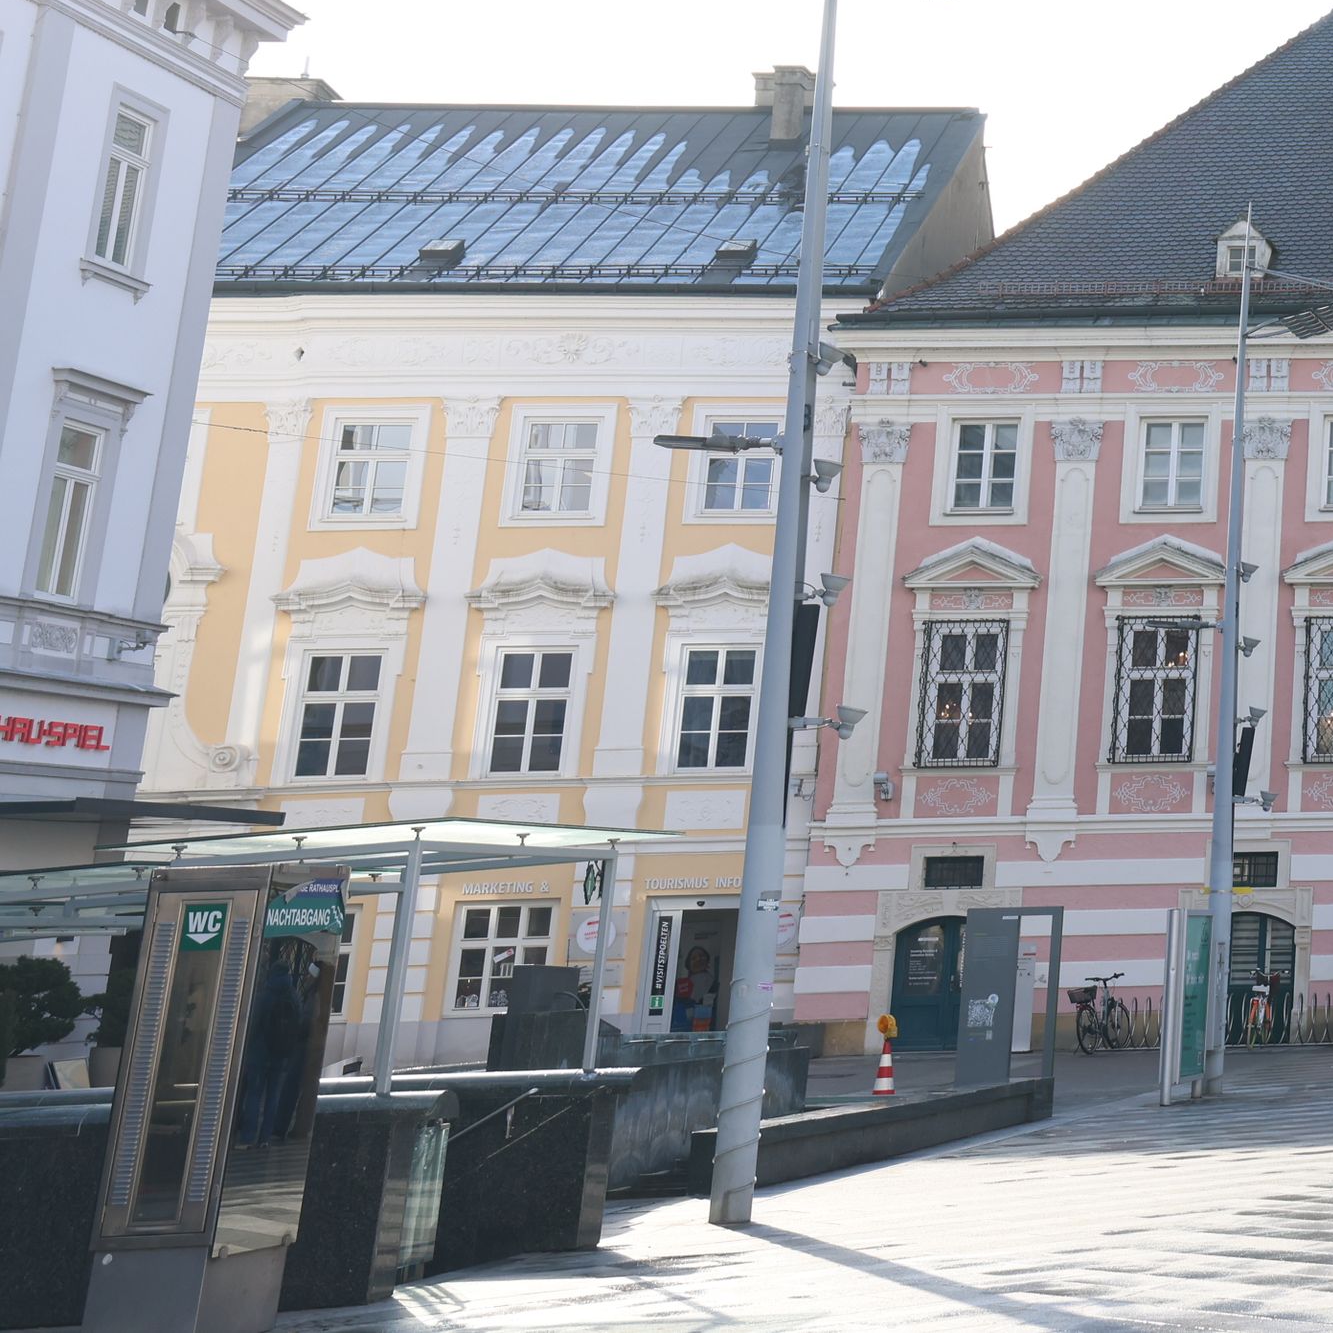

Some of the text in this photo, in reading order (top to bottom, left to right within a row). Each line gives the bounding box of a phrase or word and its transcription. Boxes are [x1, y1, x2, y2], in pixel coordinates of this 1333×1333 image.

[462, 881, 550, 895] MARKETING &
[645, 876, 741, 890] TOURISMUS INFO
[188, 910, 222, 933] WC
[266, 908, 331, 927] NACHTABGANG
[655, 921, 669, 989] #VISITSTPOELTEN
